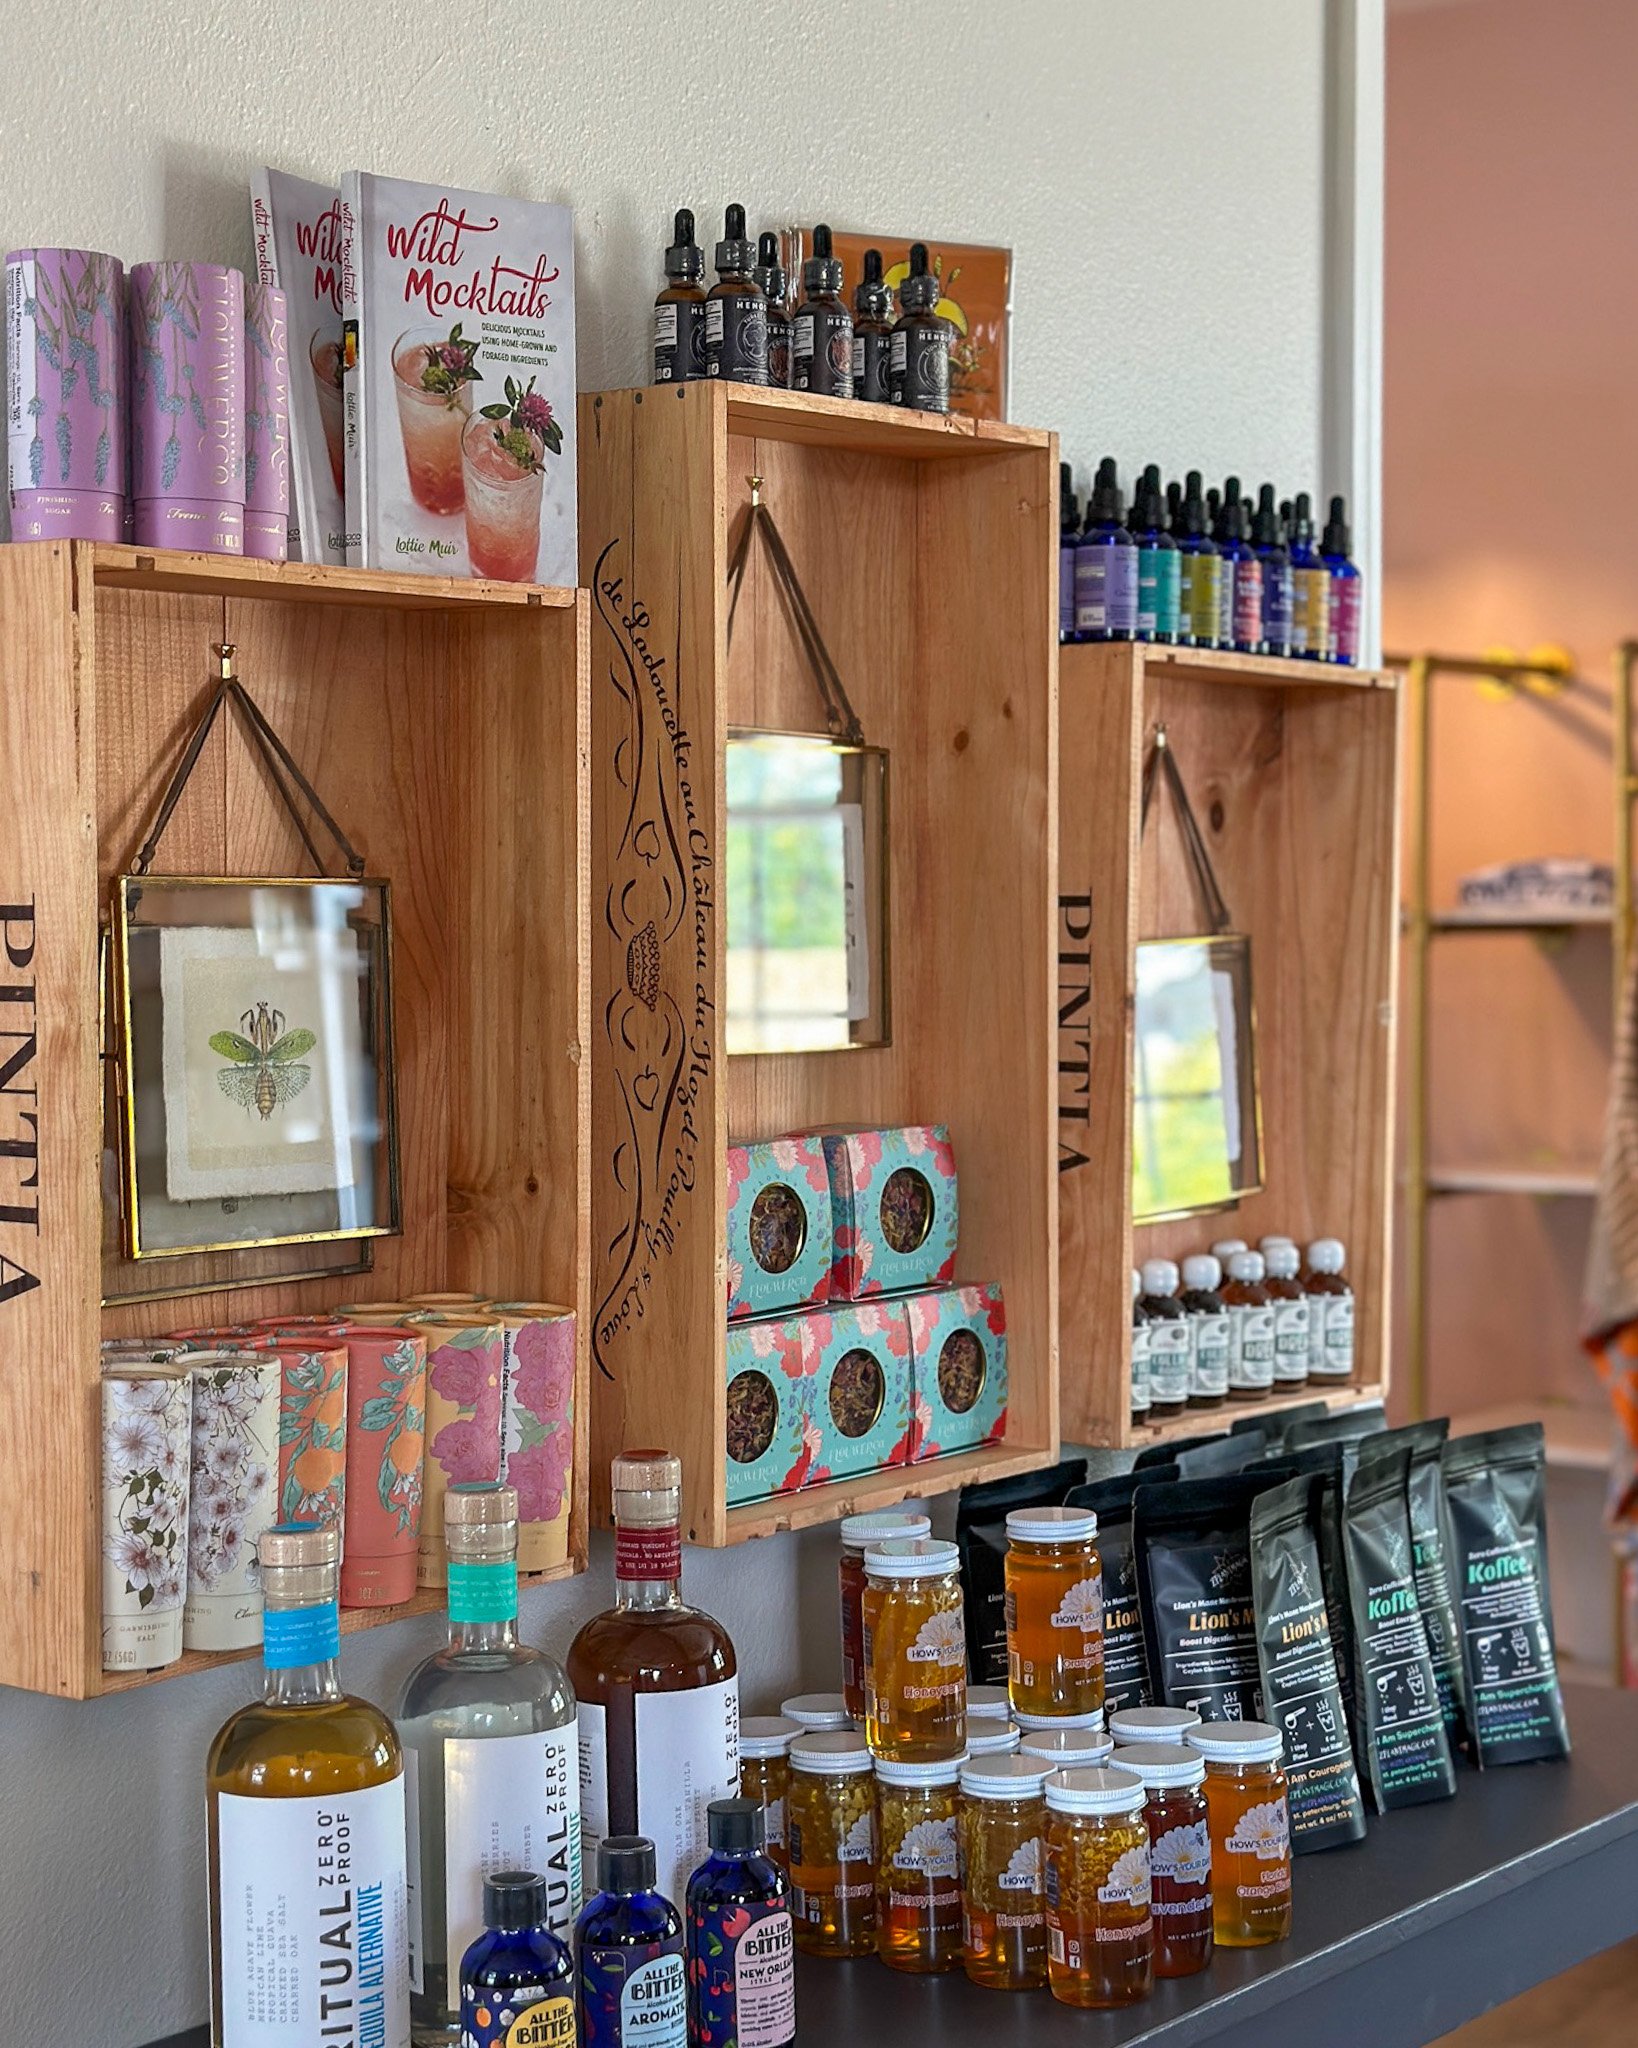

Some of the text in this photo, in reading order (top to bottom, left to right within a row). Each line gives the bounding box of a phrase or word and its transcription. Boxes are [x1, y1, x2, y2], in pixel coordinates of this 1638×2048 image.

[254, 199, 275, 286] Wild Mocktai
[297, 198, 342, 265] Wil
[387, 198, 498, 266] Wild
[342, 202, 358, 304] Wild Mocktails
[404, 253, 560, 319] Mocktails
[482, 322, 545, 338] DELICIOUS MOCKTAILS
[482, 336, 558, 353] USING HOME-GROWN AND
[482, 352, 549, 367] FORAGED INGREDIENTS
[395, 537, 459, 559] Lottie Muir
[696, 982, 715, 1032] du
[1056, 1615, 1084, 1624] HOW'S
[1189, 1608, 1240, 1632] Lion's
[1281, 1614, 1321, 1644] Lion's
[912, 1648, 941, 1658] HOW'S
[1396, 1721, 1444, 1740] Supercharg
[545, 1743, 557, 1815] ZERO
[557, 1743, 567, 1811] PROOF
[1291, 1774, 1307, 1784] Am
[1308, 1760, 1353, 1779] Courageo
[318, 1811, 334, 1887] ZERO
[336, 1812, 351, 1885] PROOF
[1230, 1840, 1261, 1849] HOW'S
[897, 1855, 927, 1866] HOW'S
[1003, 1876, 1035, 1886] HOW'S
[1103, 1886, 1133, 1899] HOW'S
[1151, 1896, 1211, 1915] avender
[357, 1880, 385, 1987] ALTERNATIVE
[756, 1918, 789, 1938] ALL THE
[267, 1909, 276, 2023] TROPICAL GUAVA
[278, 1893, 288, 2023] CRACKED SEA SALT
[740, 1959, 793, 1979] NEW ORLEA
[290, 1933, 299, 2023] CHARRED OAK
[644, 1961, 680, 1981] ALL THE
[257, 1966, 265, 2023] MEXICAN
[530, 2003, 568, 2025] ALL THE
